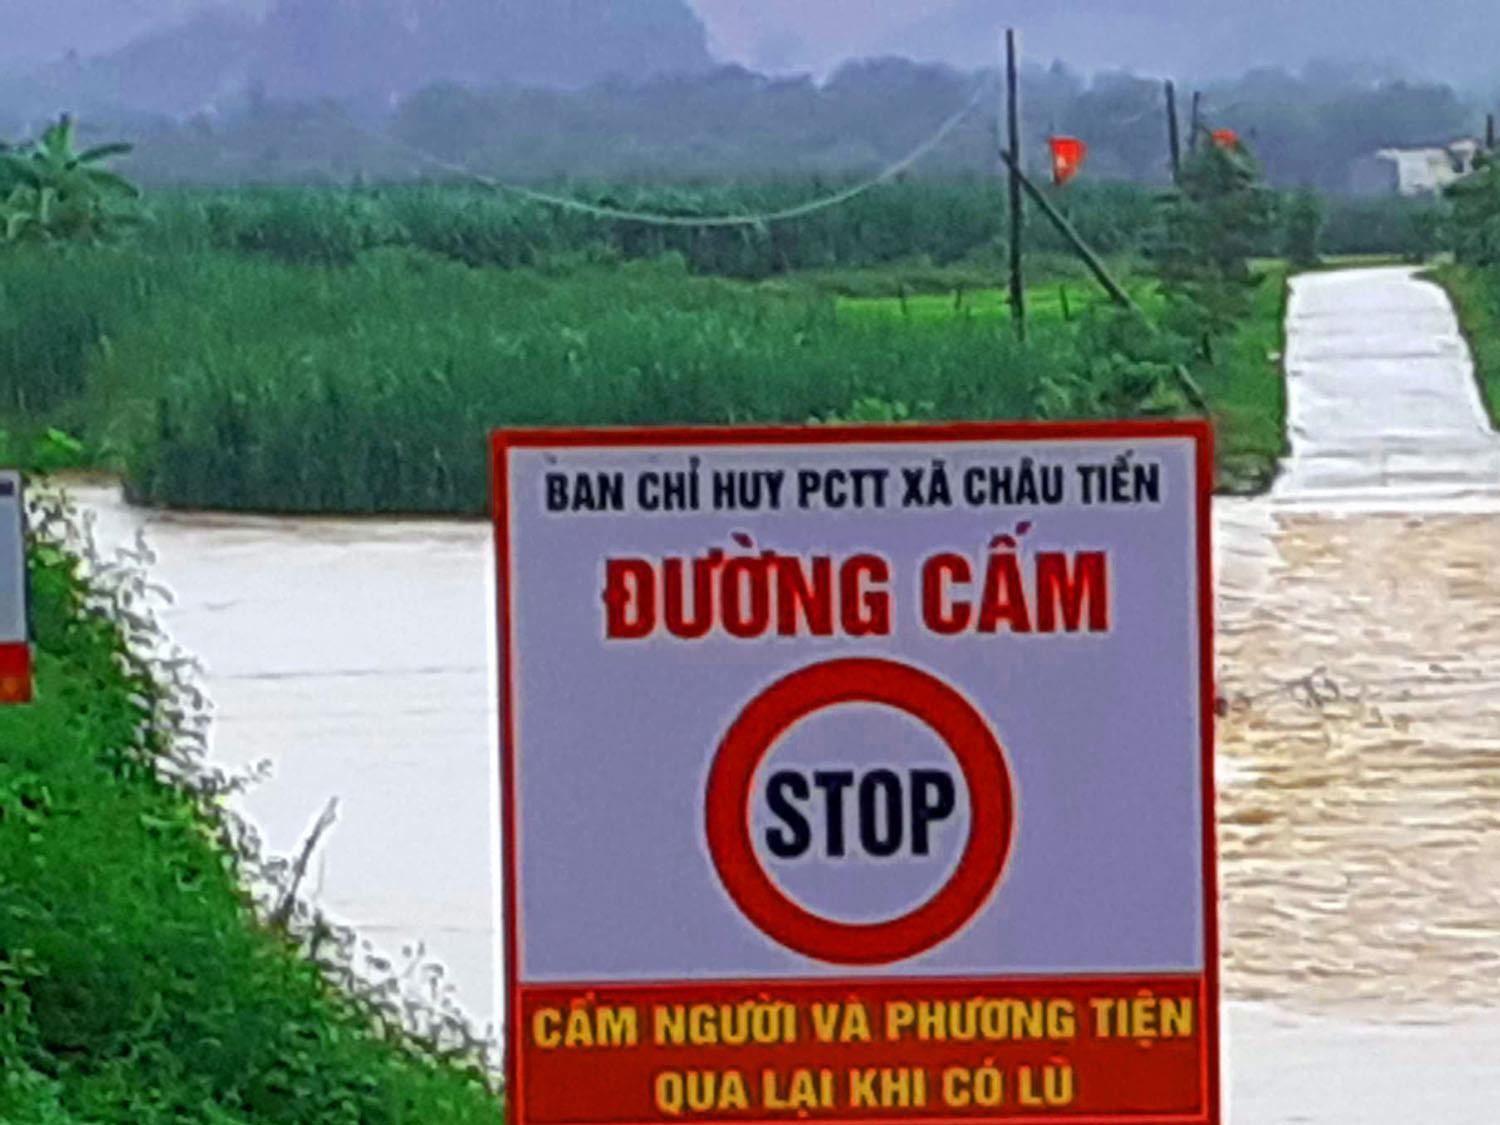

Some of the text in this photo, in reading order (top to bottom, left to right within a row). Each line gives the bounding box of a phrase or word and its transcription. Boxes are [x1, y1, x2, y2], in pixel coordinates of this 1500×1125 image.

[545, 471, 625, 512] BAN
[637, 455, 700, 511] CHỈ
[712, 469, 784, 510] HUY
[798, 467, 889, 508] PCTT
[902, 458, 952, 507] XÃ
[962, 457, 1063, 506] CHÂU
[602, 520, 1109, 640] ĐƯỜNG CẤM
[765, 768, 956, 860] STOP
[532, 989, 1193, 1048] CẤM NGƯỜI VÀ PHƯƠNG TIỆN
[654, 1070, 750, 1116] QUA
[762, 1068, 834, 1119] LẠI
[850, 1066, 926, 1108] KHI
[942, 1056, 1004, 1107] CÓ
